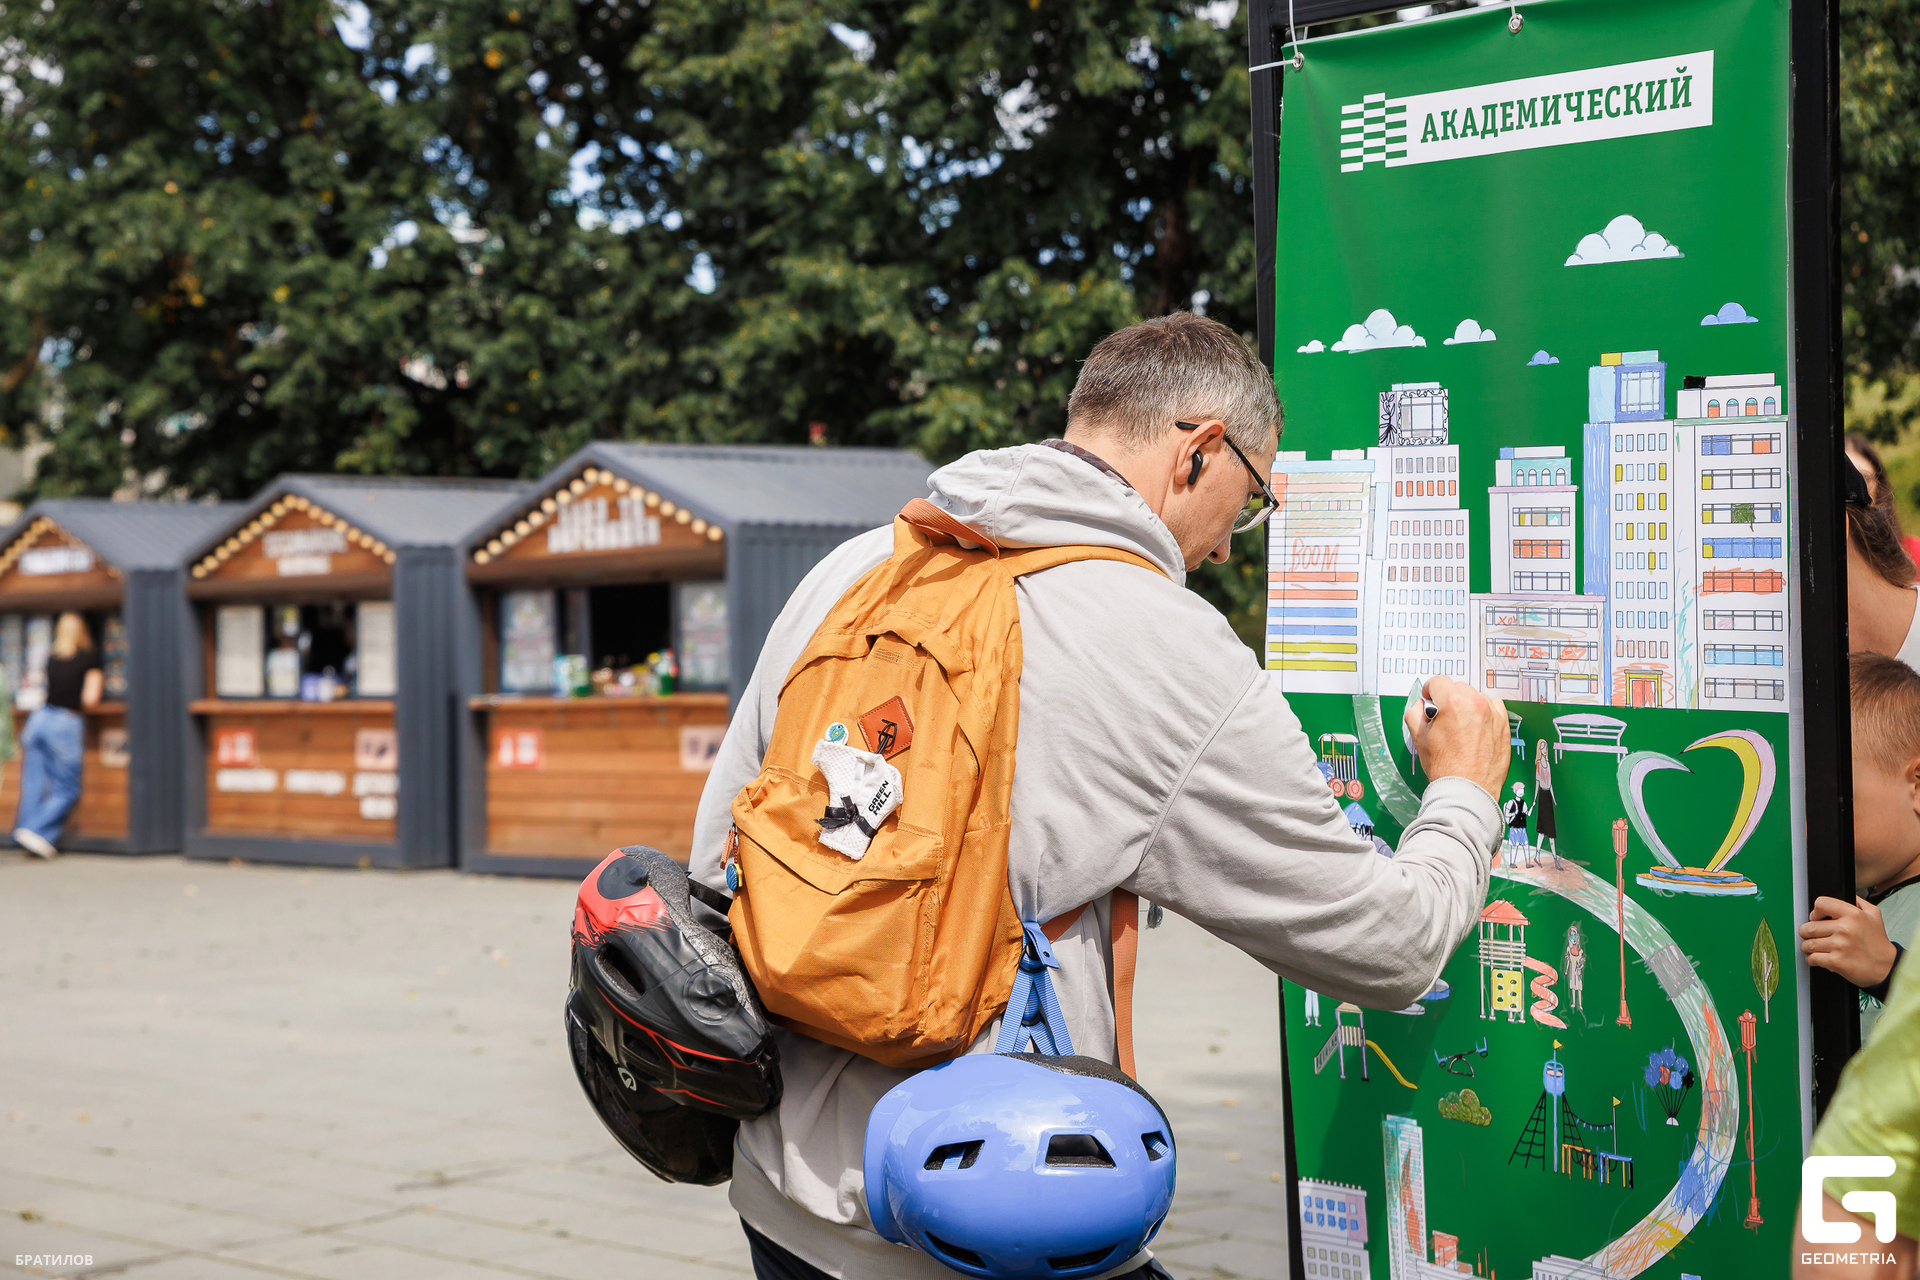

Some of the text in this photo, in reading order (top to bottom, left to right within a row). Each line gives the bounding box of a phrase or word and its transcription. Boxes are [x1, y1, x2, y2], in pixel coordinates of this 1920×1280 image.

[1420, 65, 1693, 144] АКАДЕМИЧЕСКИЙ
[1288, 536, 1340, 573] BOOM
[868, 780, 889, 812] GREEN
[873, 791, 892, 816] HILL
